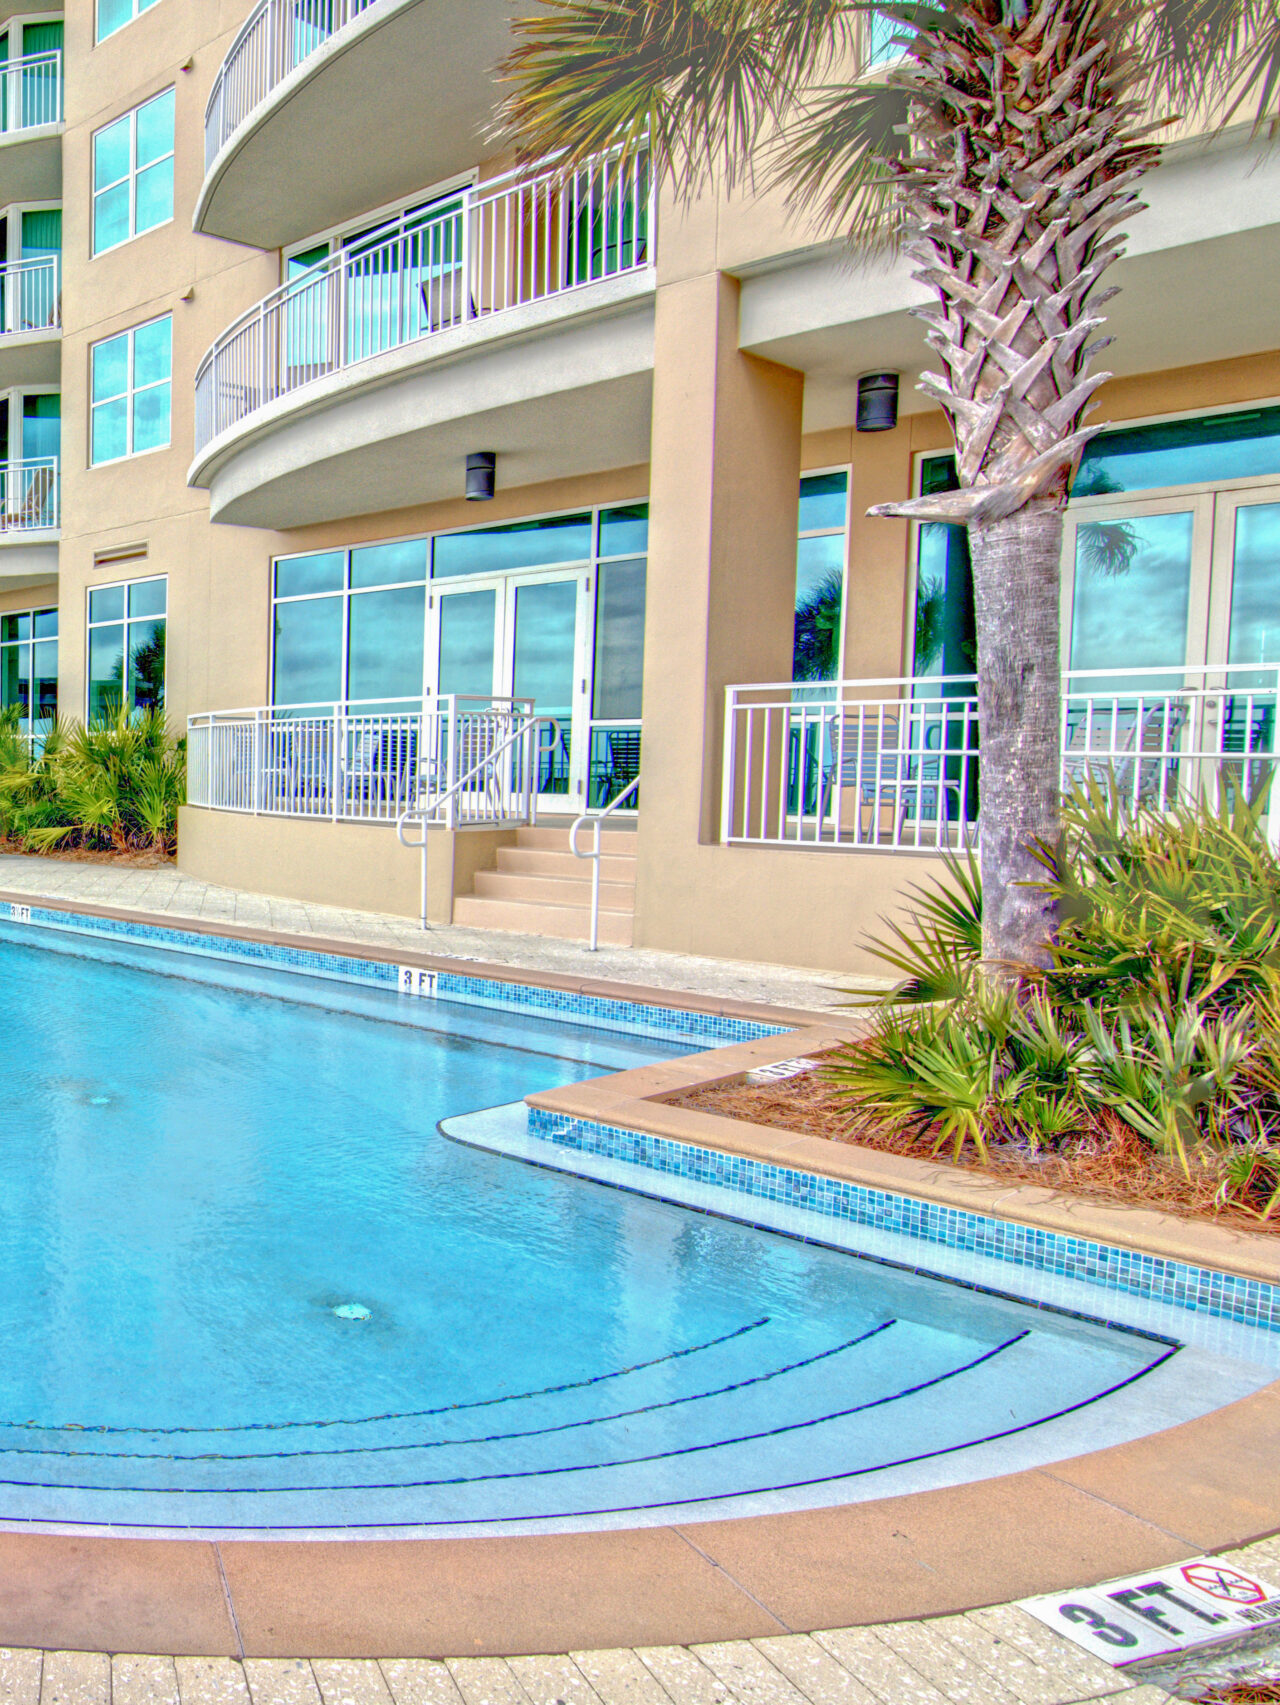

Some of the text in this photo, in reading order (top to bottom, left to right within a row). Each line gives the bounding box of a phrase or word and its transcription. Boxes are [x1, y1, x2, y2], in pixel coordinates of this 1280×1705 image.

[21, 906, 30, 917] FT
[404, 970, 436, 988] 3 FT
[1058, 1580, 1231, 1648] 3 FT.
[1234, 1608, 1267, 1624] NO
